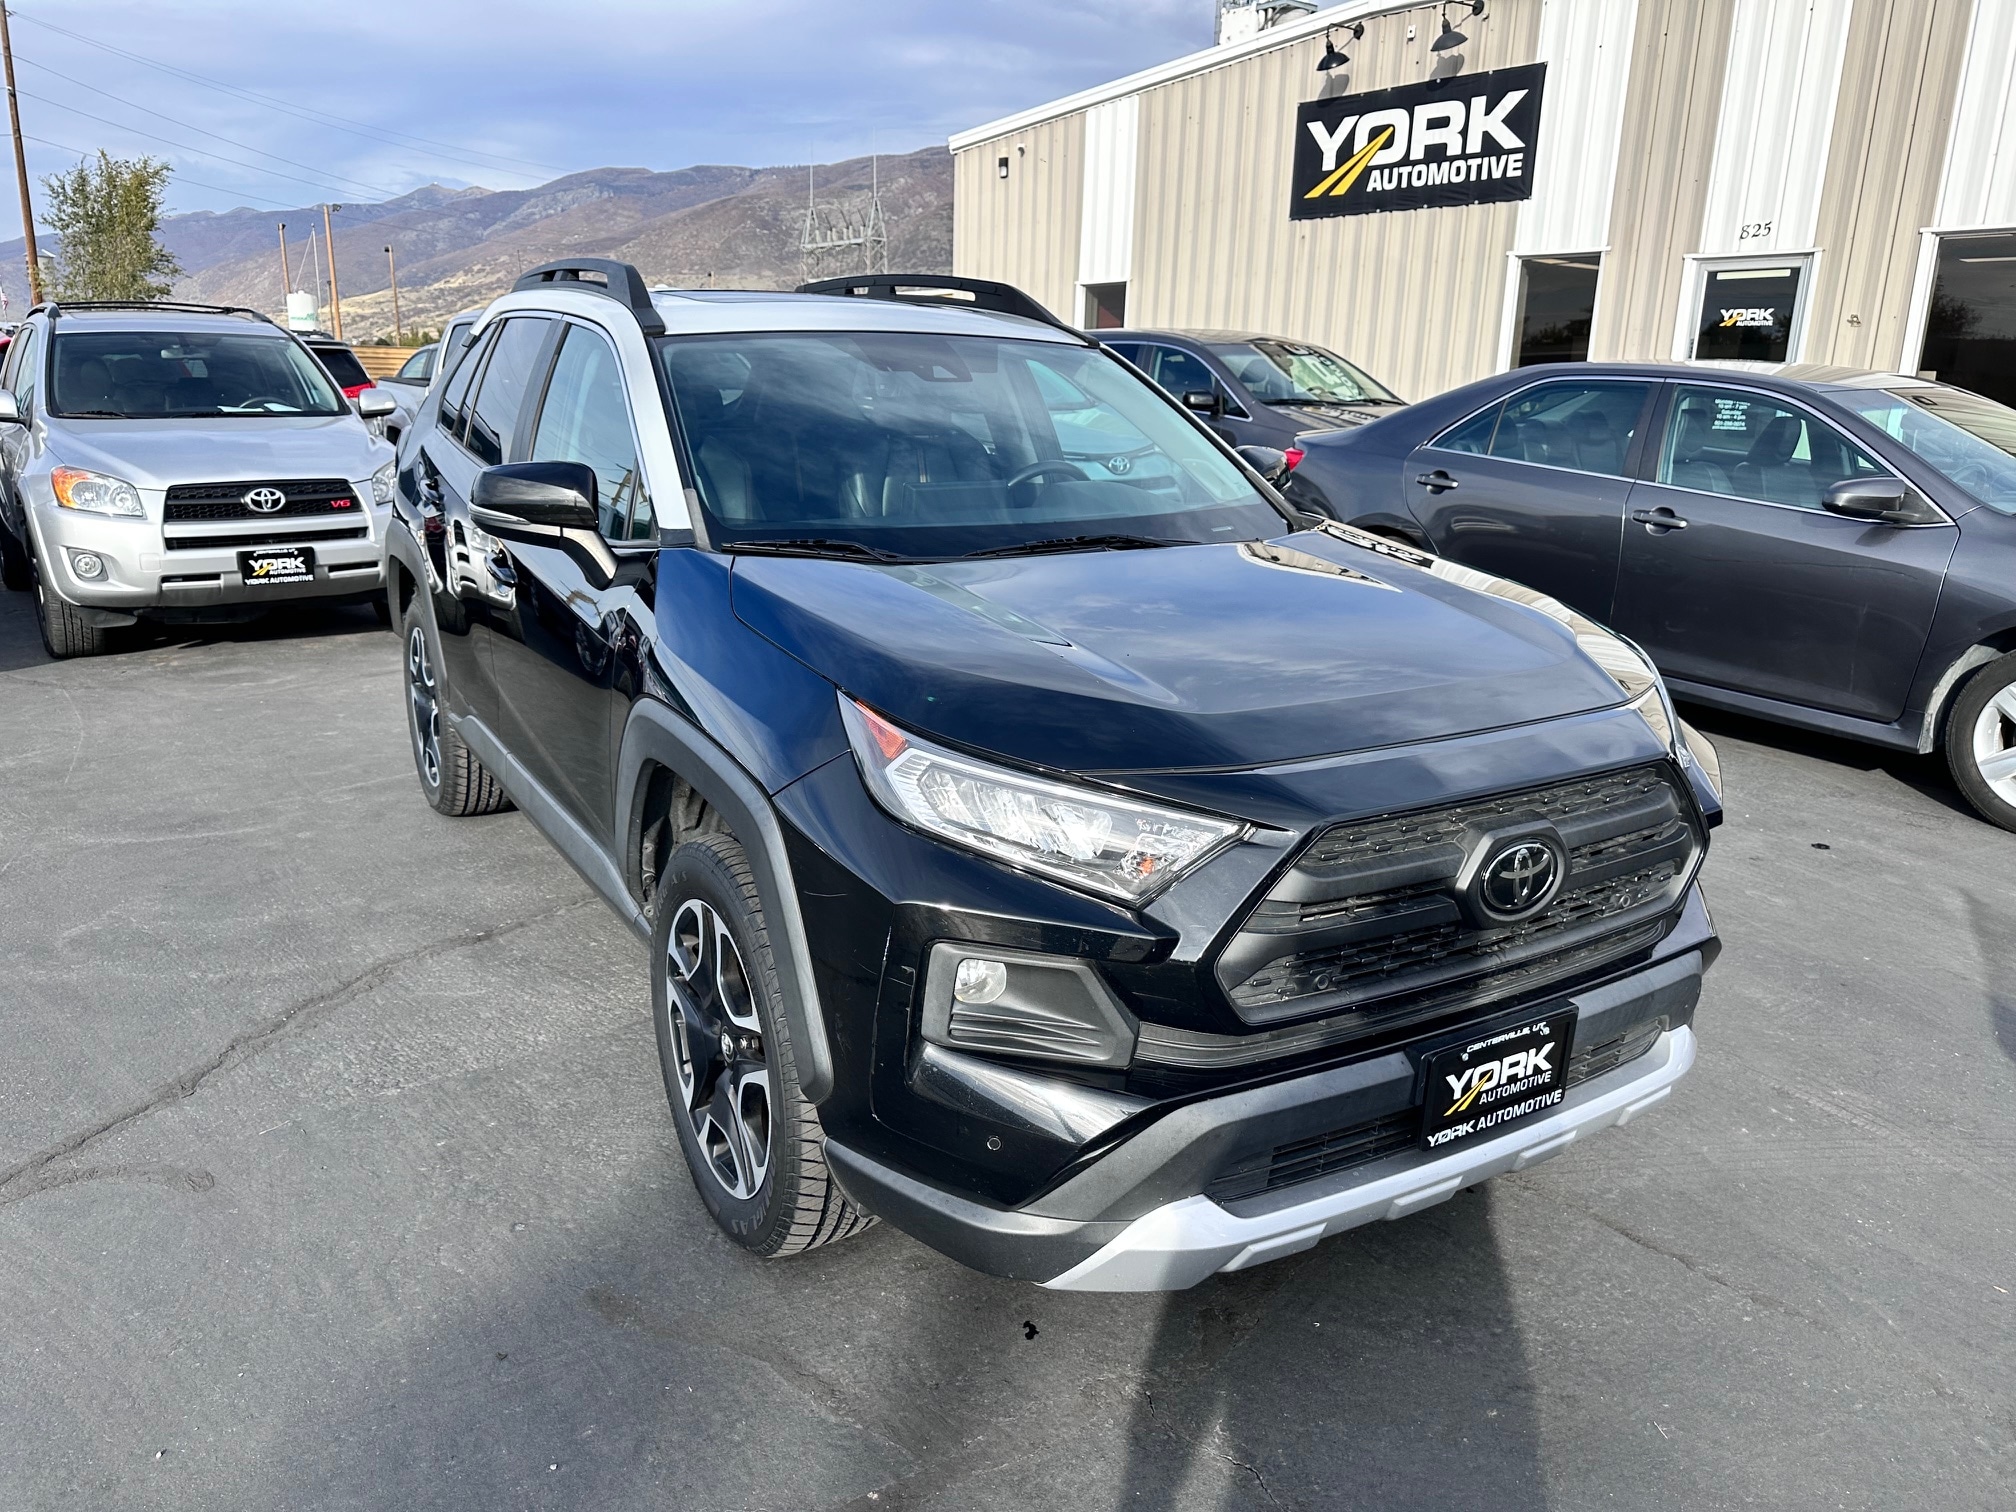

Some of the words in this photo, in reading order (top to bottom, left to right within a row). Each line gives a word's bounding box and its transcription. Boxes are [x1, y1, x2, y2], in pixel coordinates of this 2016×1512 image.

[1306, 89, 1529, 171] YORK
[1366, 153, 1523, 192] AUTOMOTIVE
[1739, 221, 1772, 240] 825
[1720, 308, 1775, 321] YORK
[1735, 319, 1773, 327] AUTOMOTIVE
[331, 500, 350, 508] V6
[248, 556, 306, 571] YORK
[269, 567, 306, 575] AUTOMOTIVE
[244, 577, 270, 585] YORK
[270, 574, 314, 584] AUTOMOTIVE
[1445, 1041, 1555, 1100] YORK
[1479, 1071, 1552, 1105] AUTOMOTIVE
[1427, 1120, 1475, 1148] YORK
[1476, 1089, 1562, 1131] AUTOMOTIVE
